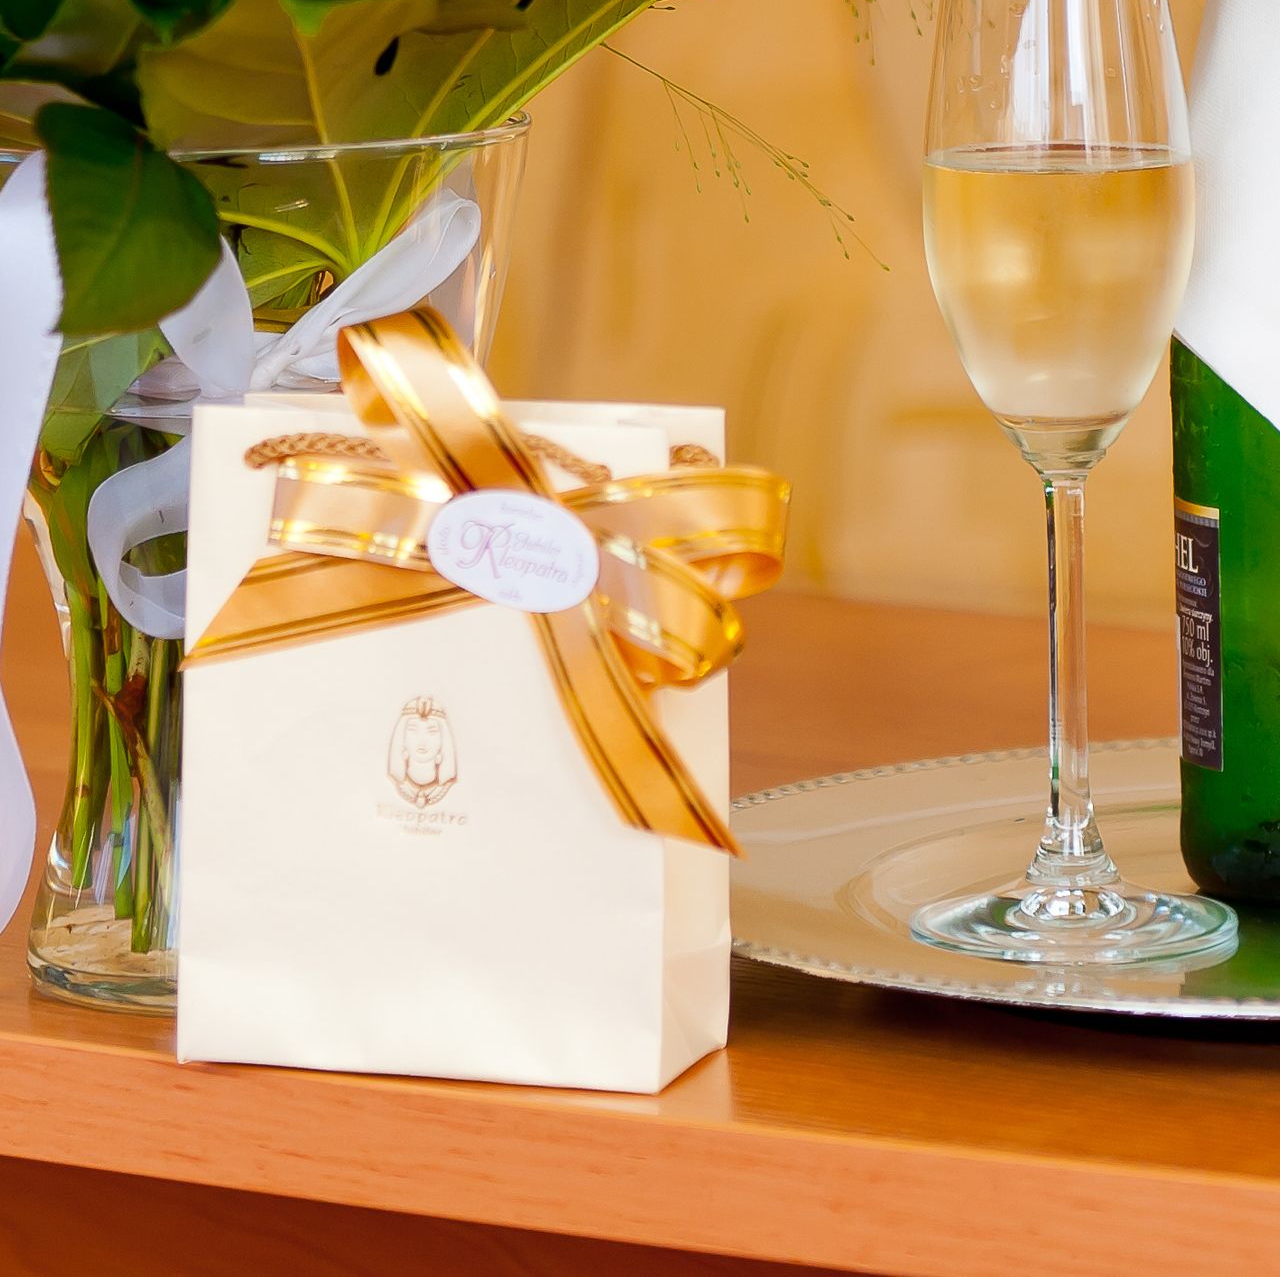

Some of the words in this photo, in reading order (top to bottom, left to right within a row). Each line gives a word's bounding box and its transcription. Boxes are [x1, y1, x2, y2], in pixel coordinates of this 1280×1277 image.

[1181, 615, 1195, 637] 750
[1196, 622, 1210, 642] ml
[1196, 641, 1213, 668] obj.
